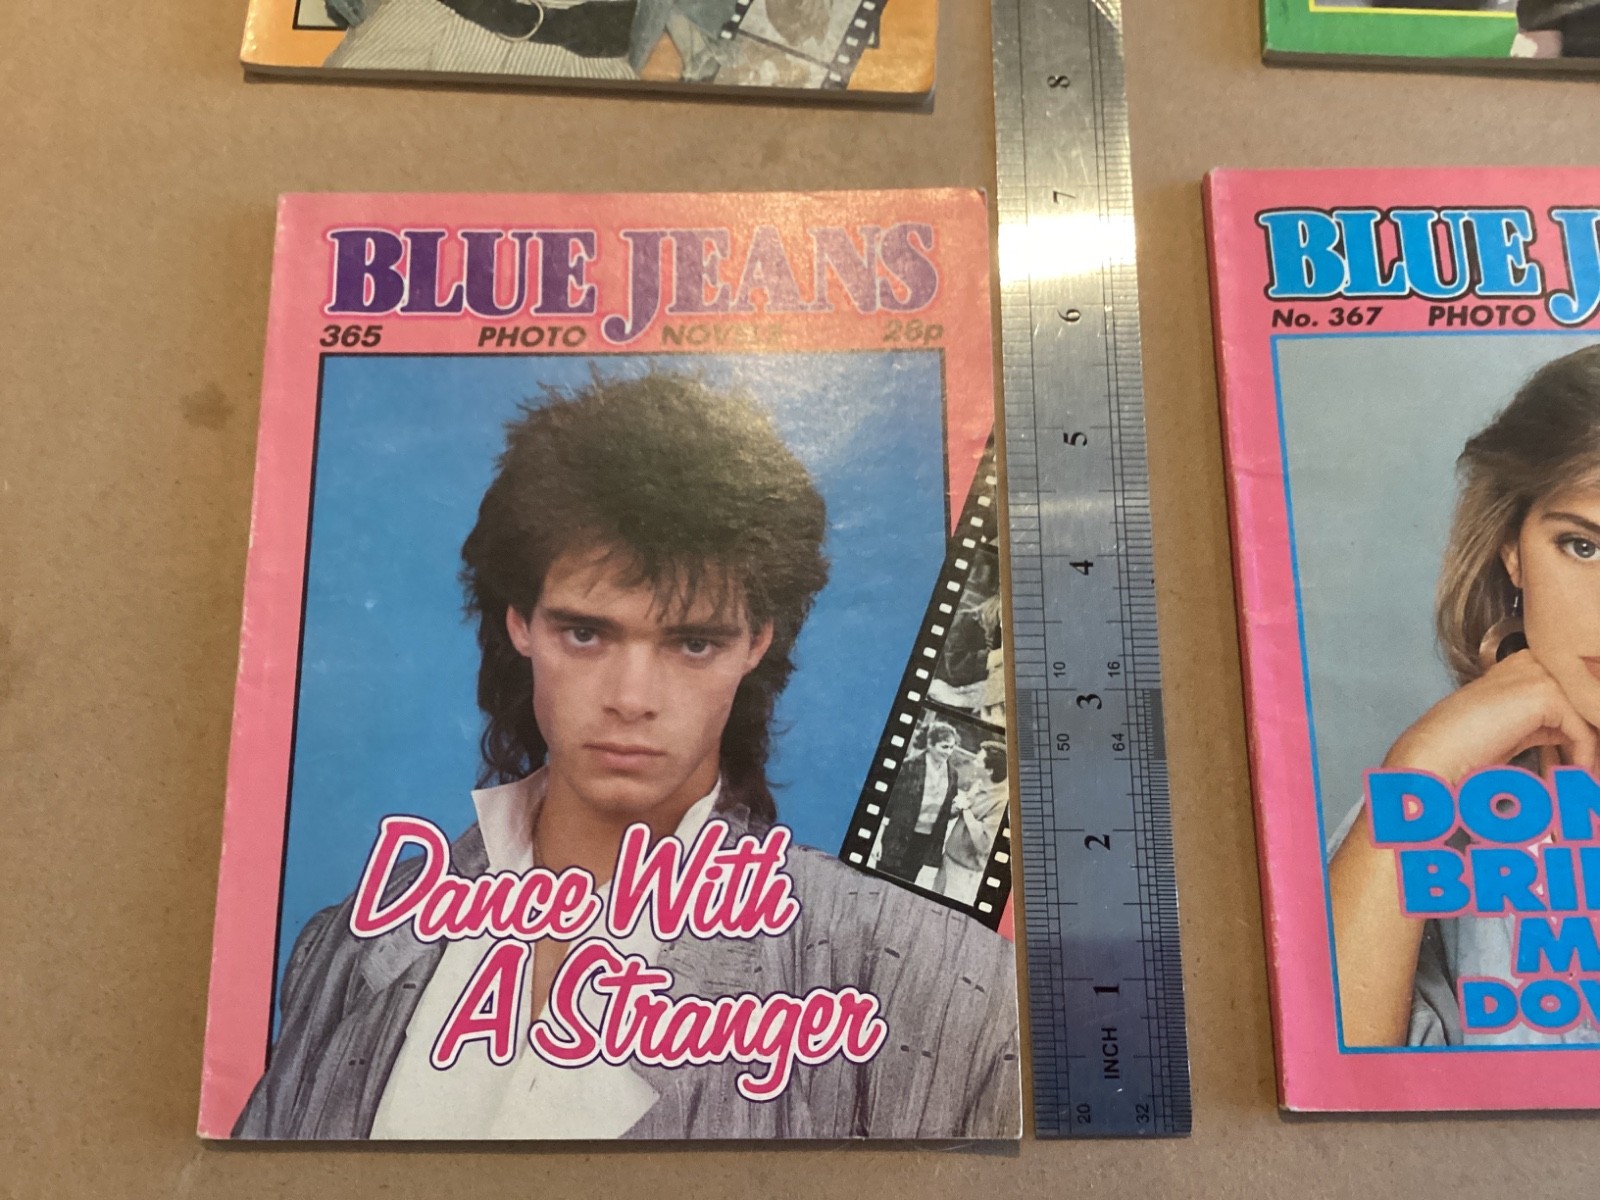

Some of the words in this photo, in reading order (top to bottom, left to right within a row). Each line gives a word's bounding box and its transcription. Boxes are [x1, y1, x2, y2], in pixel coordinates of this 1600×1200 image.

[1047, 75, 1071, 89] 8
[1052, 189, 1076, 204] 7
[1256, 207, 1543, 300] BLUE
[326, 226, 598, 318] BLUE
[601, 223, 939, 345] JEANS
[1057, 308, 1081, 324] 6
[1271, 308, 1318, 328] No.
[1328, 305, 1383, 327] 367
[1427, 304, 1537, 327] PHOTO
[319, 324, 384, 348] 365
[477, 325, 587, 348] PHOTO
[1063, 431, 1089, 447] 5
[1069, 559, 1094, 576] 4
[1053, 660, 1067, 679] 10
[1107, 660, 1121, 678] 16
[1076, 693, 1103, 710] 3
[1056, 732, 1070, 752] 50
[1112, 732, 1126, 752] 64
[1083, 833, 1111, 852] 2
[351, 815, 602, 942] Dance
[606, 818, 801, 941] With
[1093, 984, 1121, 996] 1
[430, 939, 531, 1071] A
[529, 939, 889, 1102] Stranger
[1101, 1026, 1120, 1080] INCH
[1076, 1103, 1091, 1125] 20
[1135, 1103, 1150, 1125] 32
